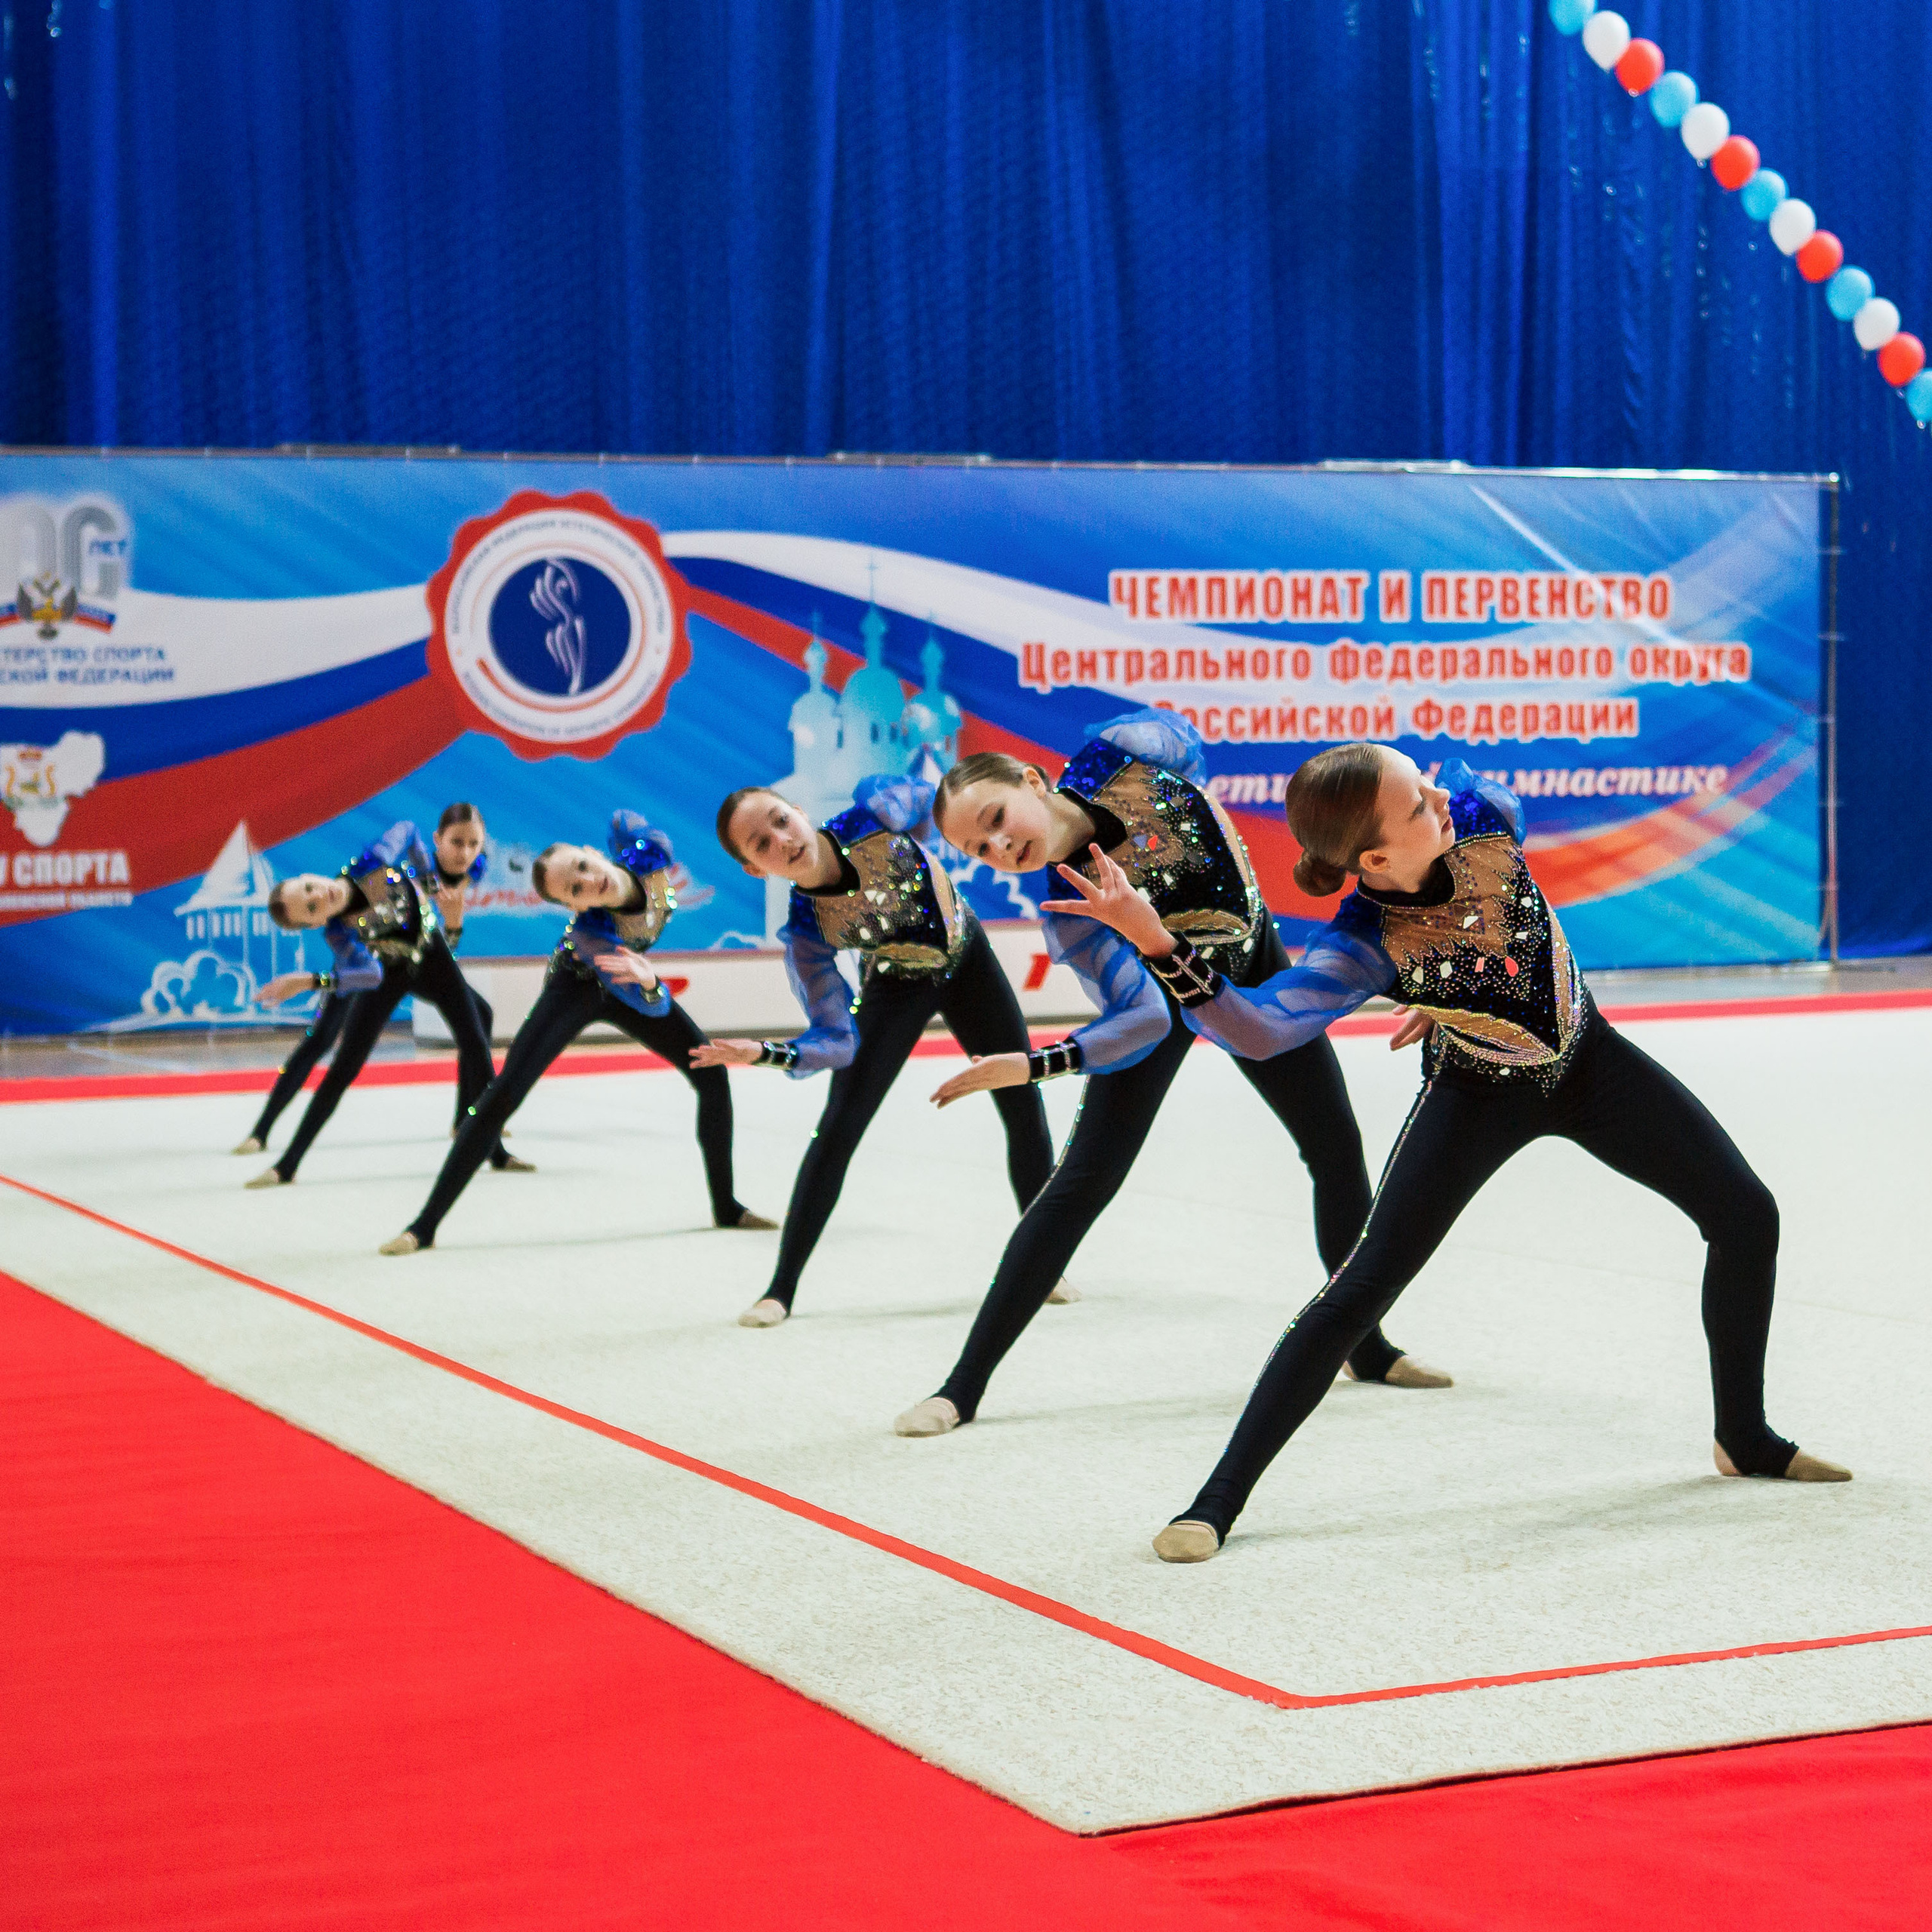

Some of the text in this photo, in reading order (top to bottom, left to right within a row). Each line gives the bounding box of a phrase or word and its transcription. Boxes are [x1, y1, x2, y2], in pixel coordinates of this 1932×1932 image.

[1112, 575, 1670, 620] ЧЕМПИОНАТ И ПЕРВЕНСТВО
[93, 646, 165, 663] СПОРТА
[1022, 642, 1312, 685] Центрального
[1628, 645, 1749, 685] округа
[57, 668, 175, 685] ФЕДЕРАЦИИ
[1154, 695, 1636, 741] оссийской Федерации
[13, 852, 131, 887] СПОРТА
